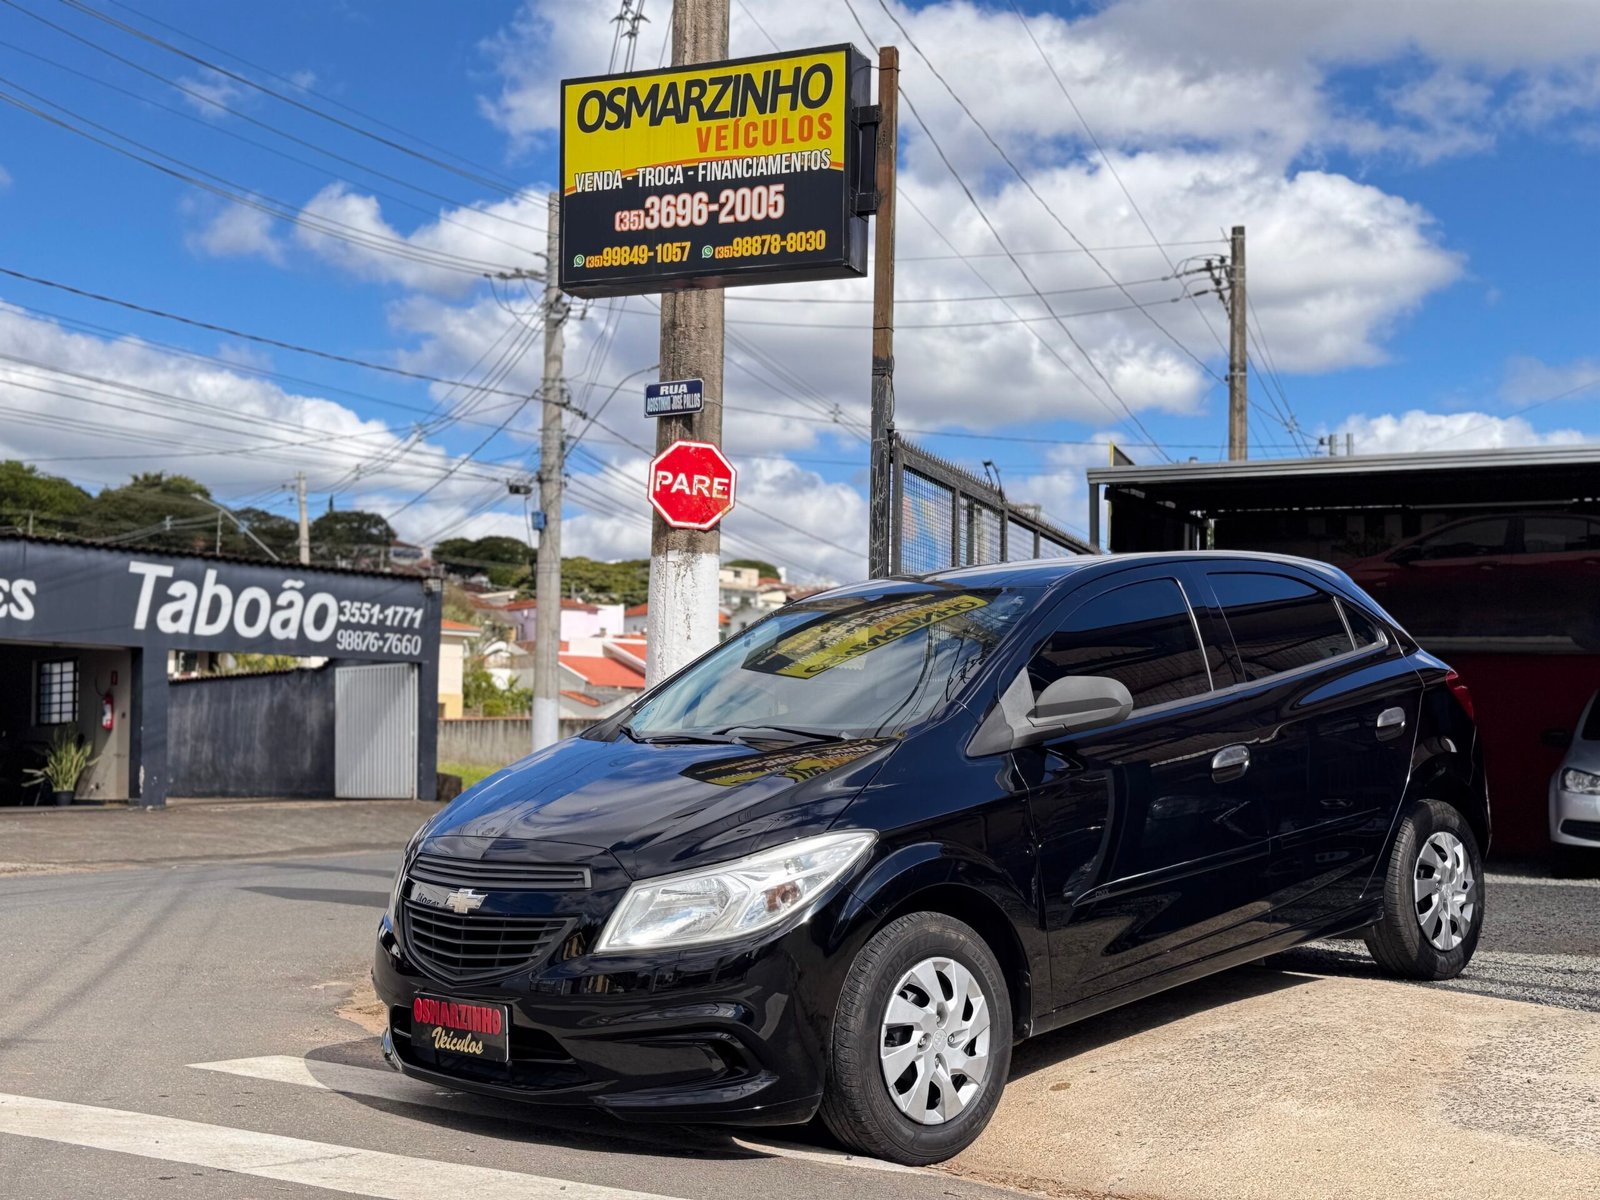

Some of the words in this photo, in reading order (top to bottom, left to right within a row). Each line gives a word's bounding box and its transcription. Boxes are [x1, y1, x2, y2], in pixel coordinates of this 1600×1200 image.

[577, 62, 834, 134] OSMARZINHO
[696, 112, 833, 153] VEÍCULOS
[574, 169, 623, 193] VENDA
[636, 164, 684, 188] TROCA
[697, 148, 831, 183] FINANCIAMENTOS
[614, 183, 785, 232] (35)3696-2005
[660, 384, 688, 395] RUA
[655, 470, 729, 499] PARE
[128, 560, 338, 643] Taboão
[413, 997, 502, 1035] OSMARZINHO
